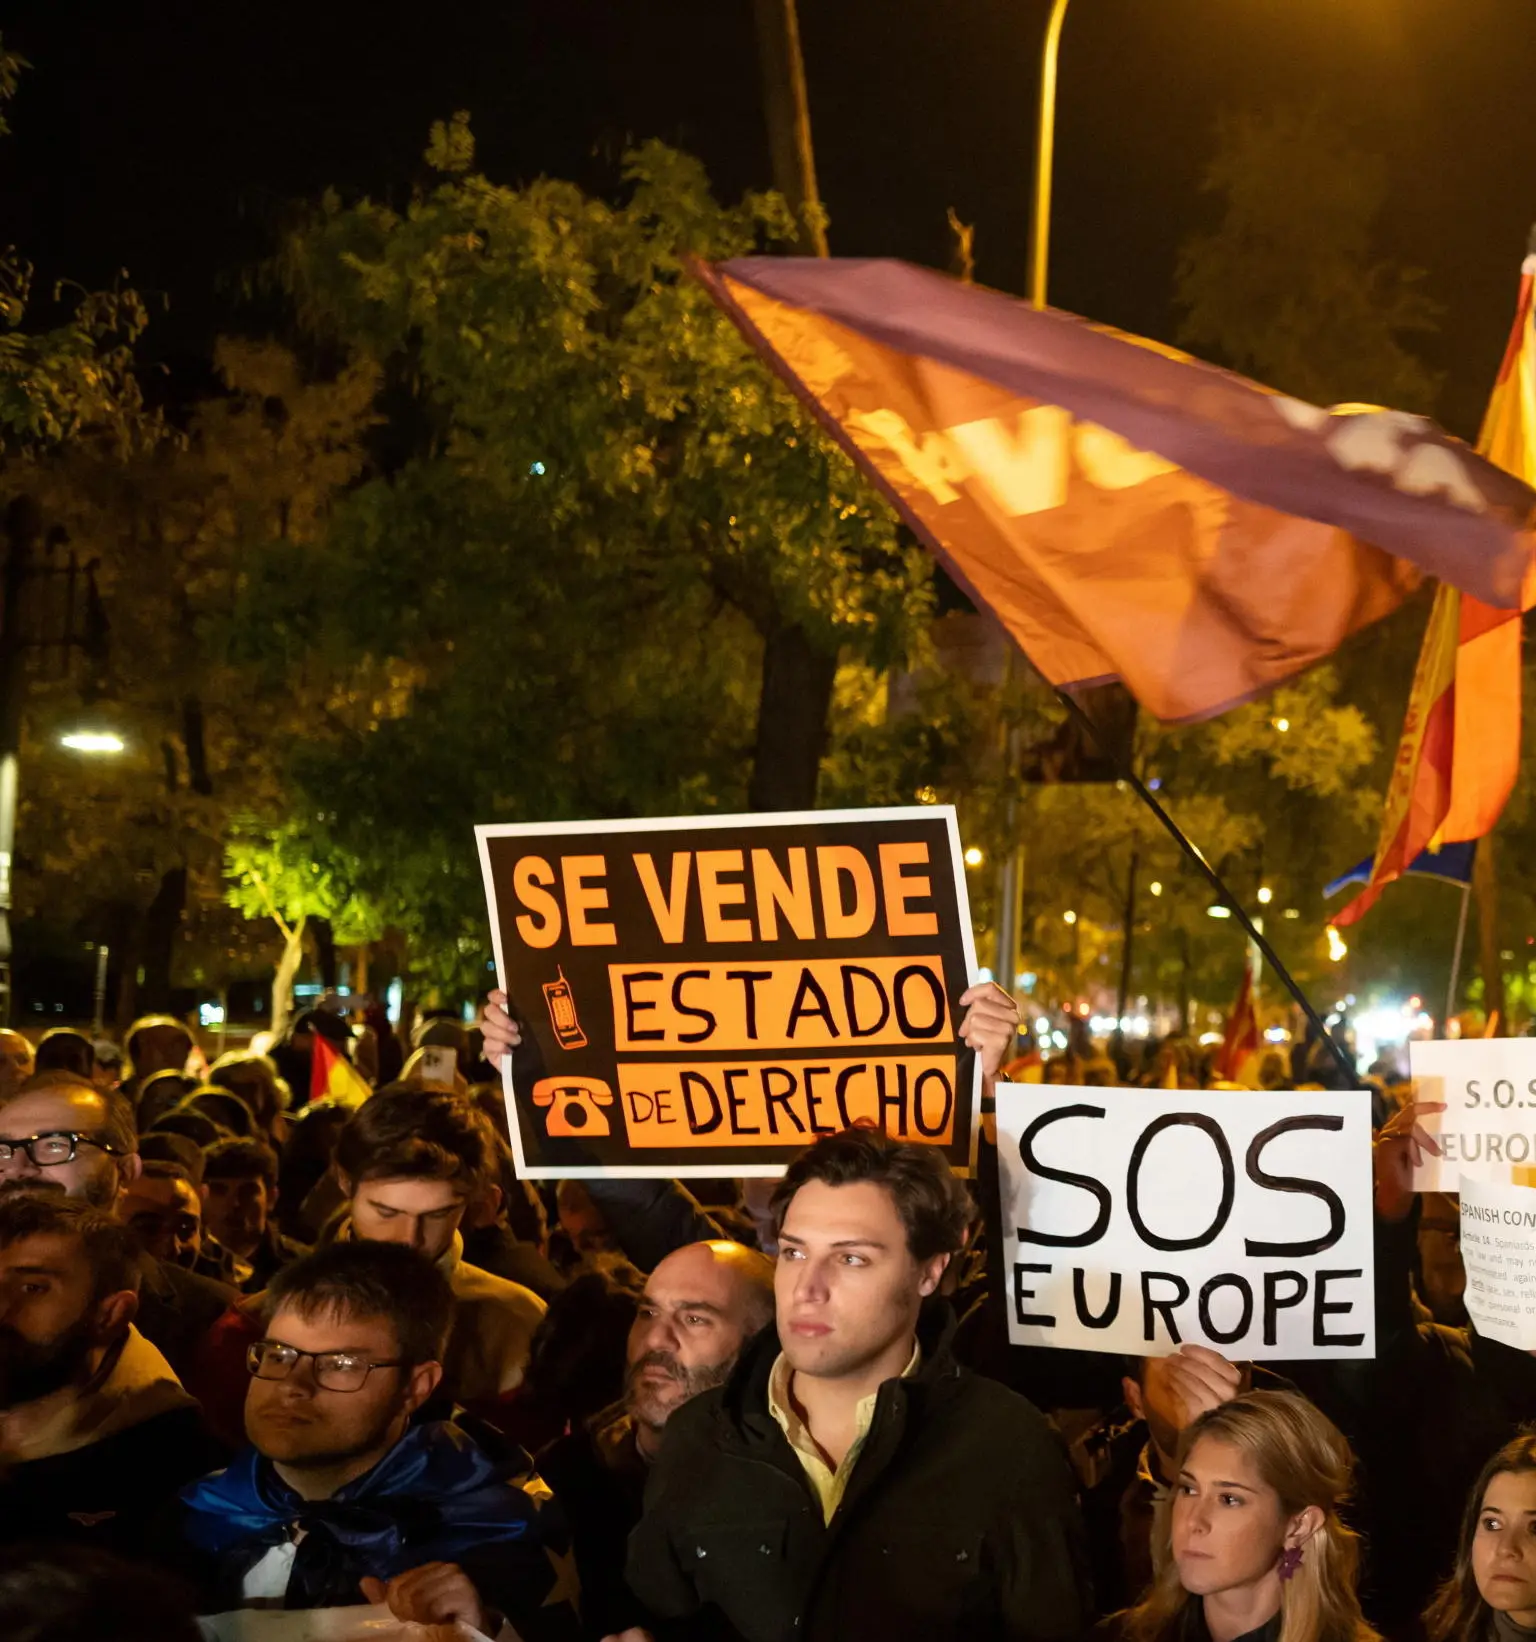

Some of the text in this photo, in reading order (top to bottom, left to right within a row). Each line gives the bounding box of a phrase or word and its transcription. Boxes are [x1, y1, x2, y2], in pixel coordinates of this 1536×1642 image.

[513, 842, 939, 948] SE VENDE
[622, 964, 945, 1042] ESTADO
[629, 1063, 952, 1137] DE DERECHO
[1017, 1104, 1345, 1257] SOS
[1461, 1202, 1500, 1224] SPANISH
[1014, 1263, 1365, 1346] EUROPE
[1525, 1306, 1536, 1315] or
